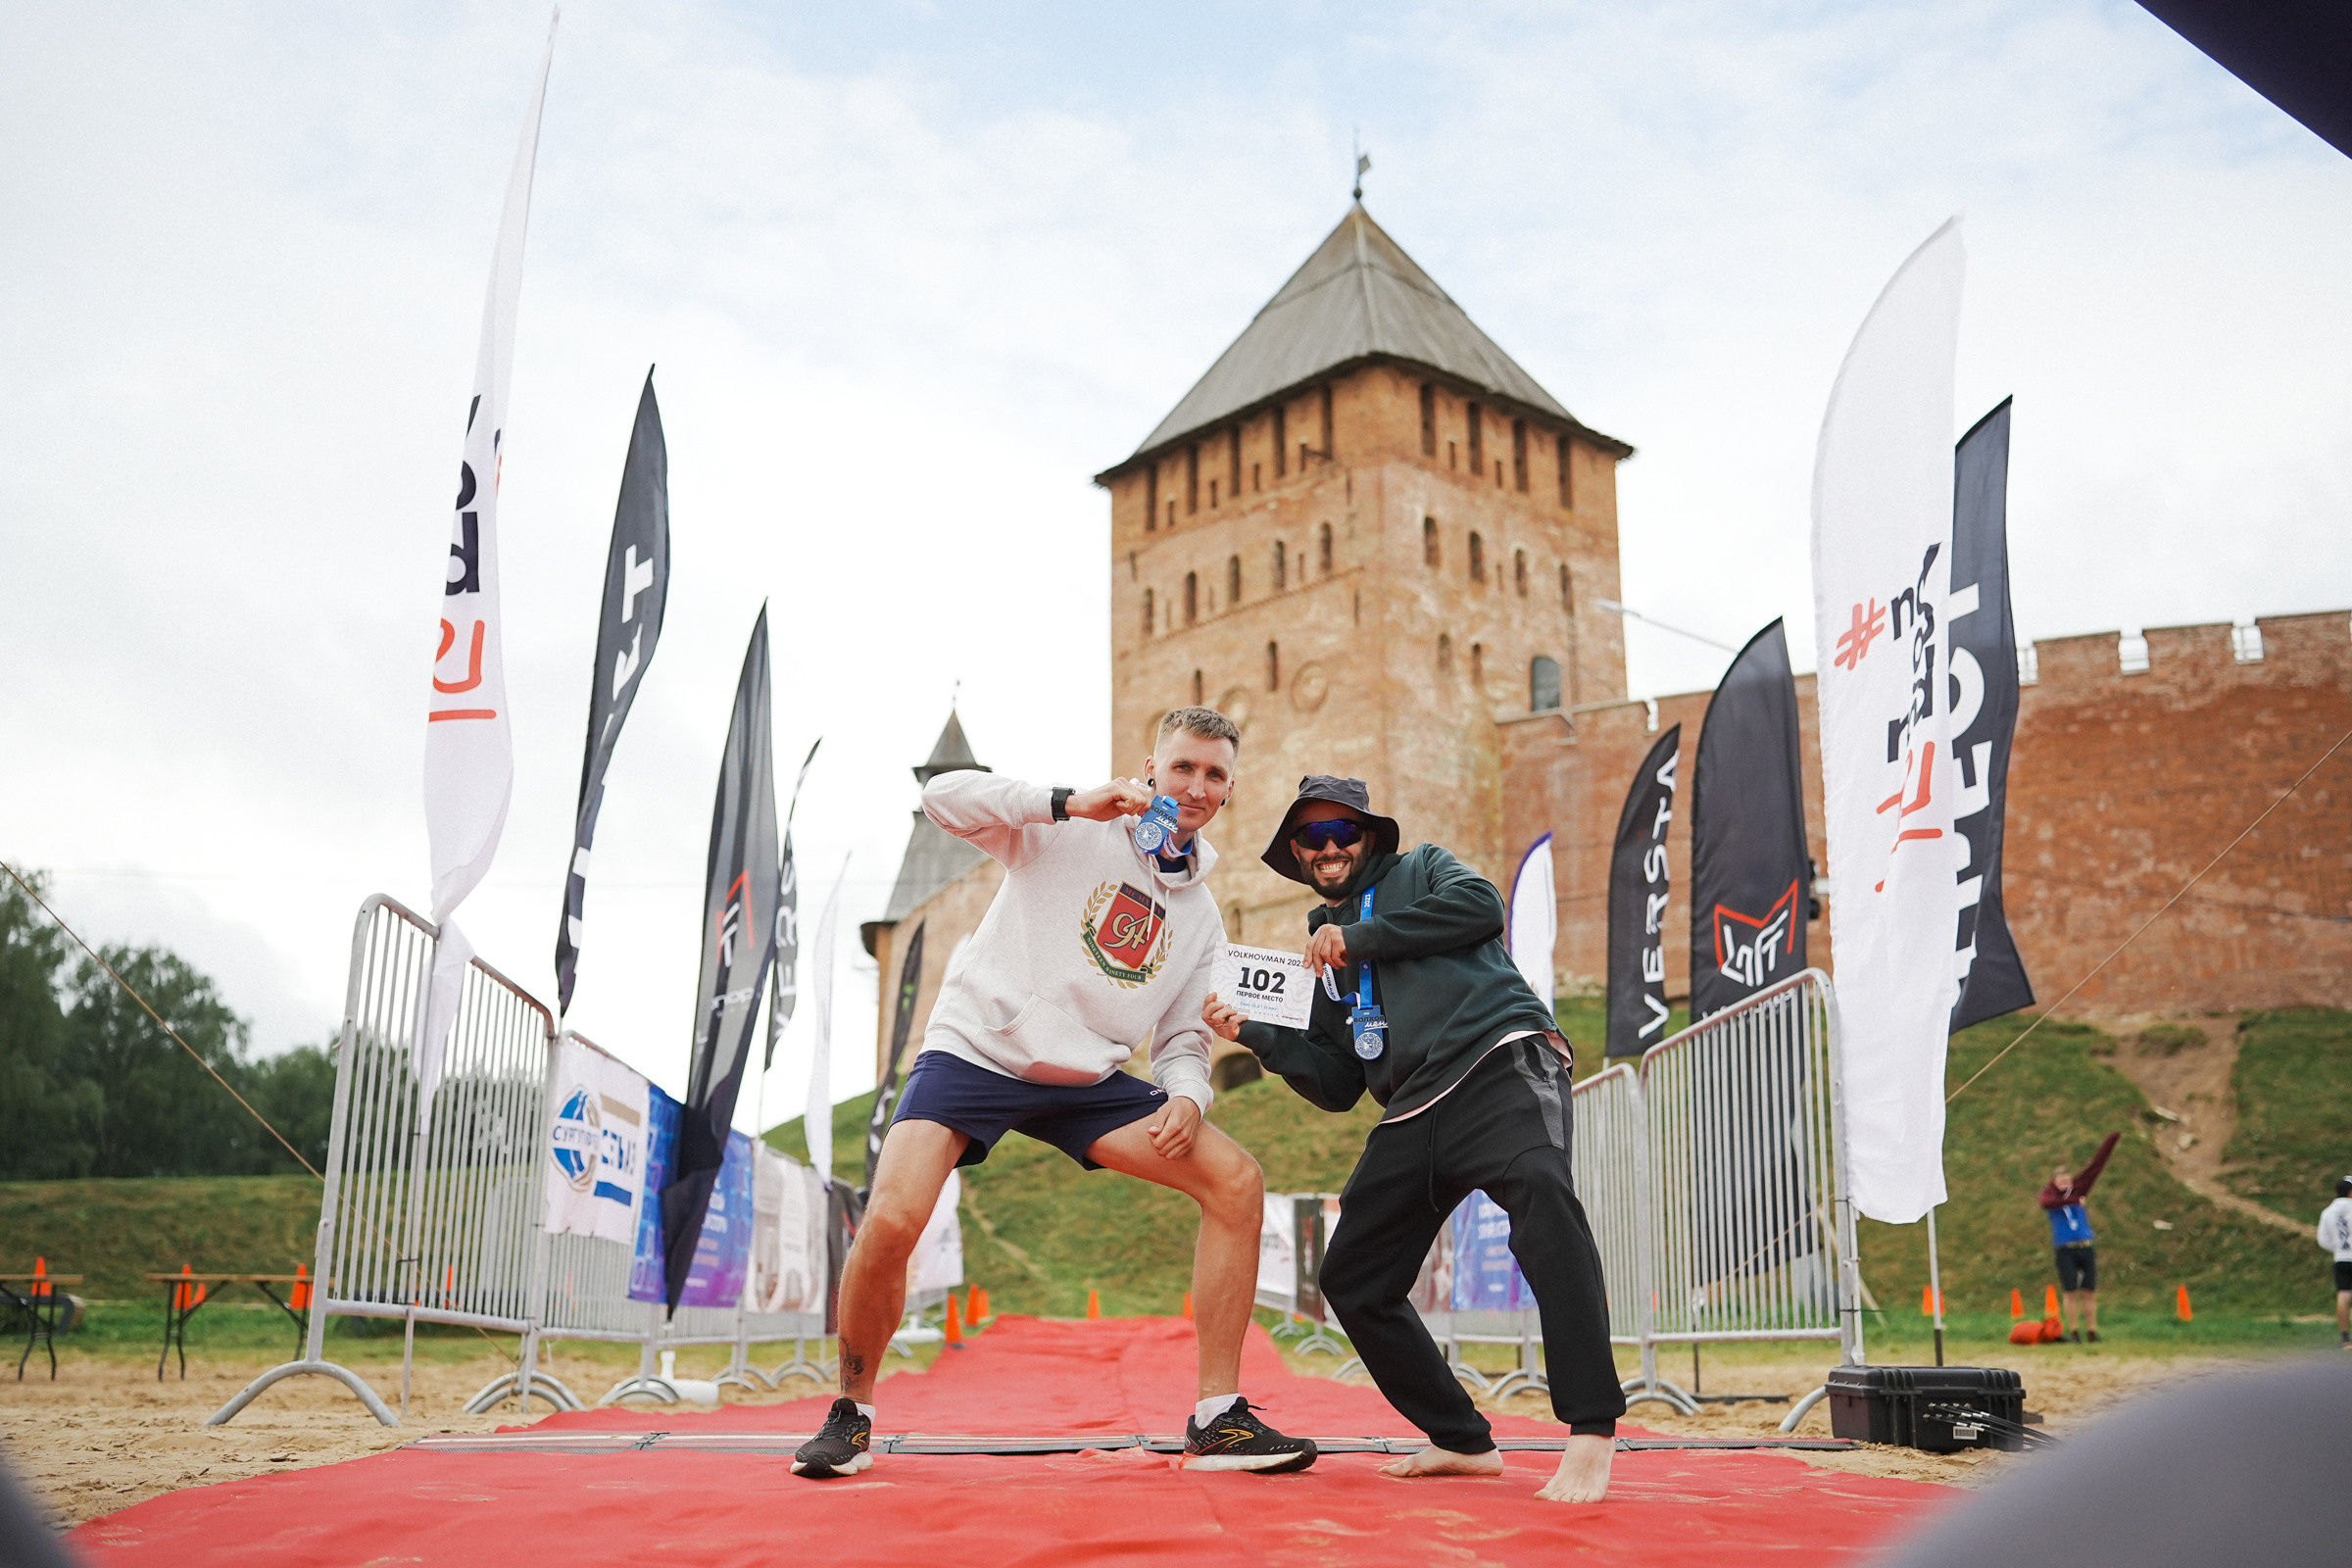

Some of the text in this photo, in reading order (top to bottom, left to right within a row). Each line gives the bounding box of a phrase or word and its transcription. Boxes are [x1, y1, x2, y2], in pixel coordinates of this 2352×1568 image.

[1087, 937, 1105, 966] NINETEEN
[1126, 972, 1142, 981] FOUR
[1227, 950, 1286, 964] VOLKHOVMAN
[1238, 966, 1286, 995] 102
[1236, 990, 1284, 1004] ПЕРВОЕ МЕСТО
